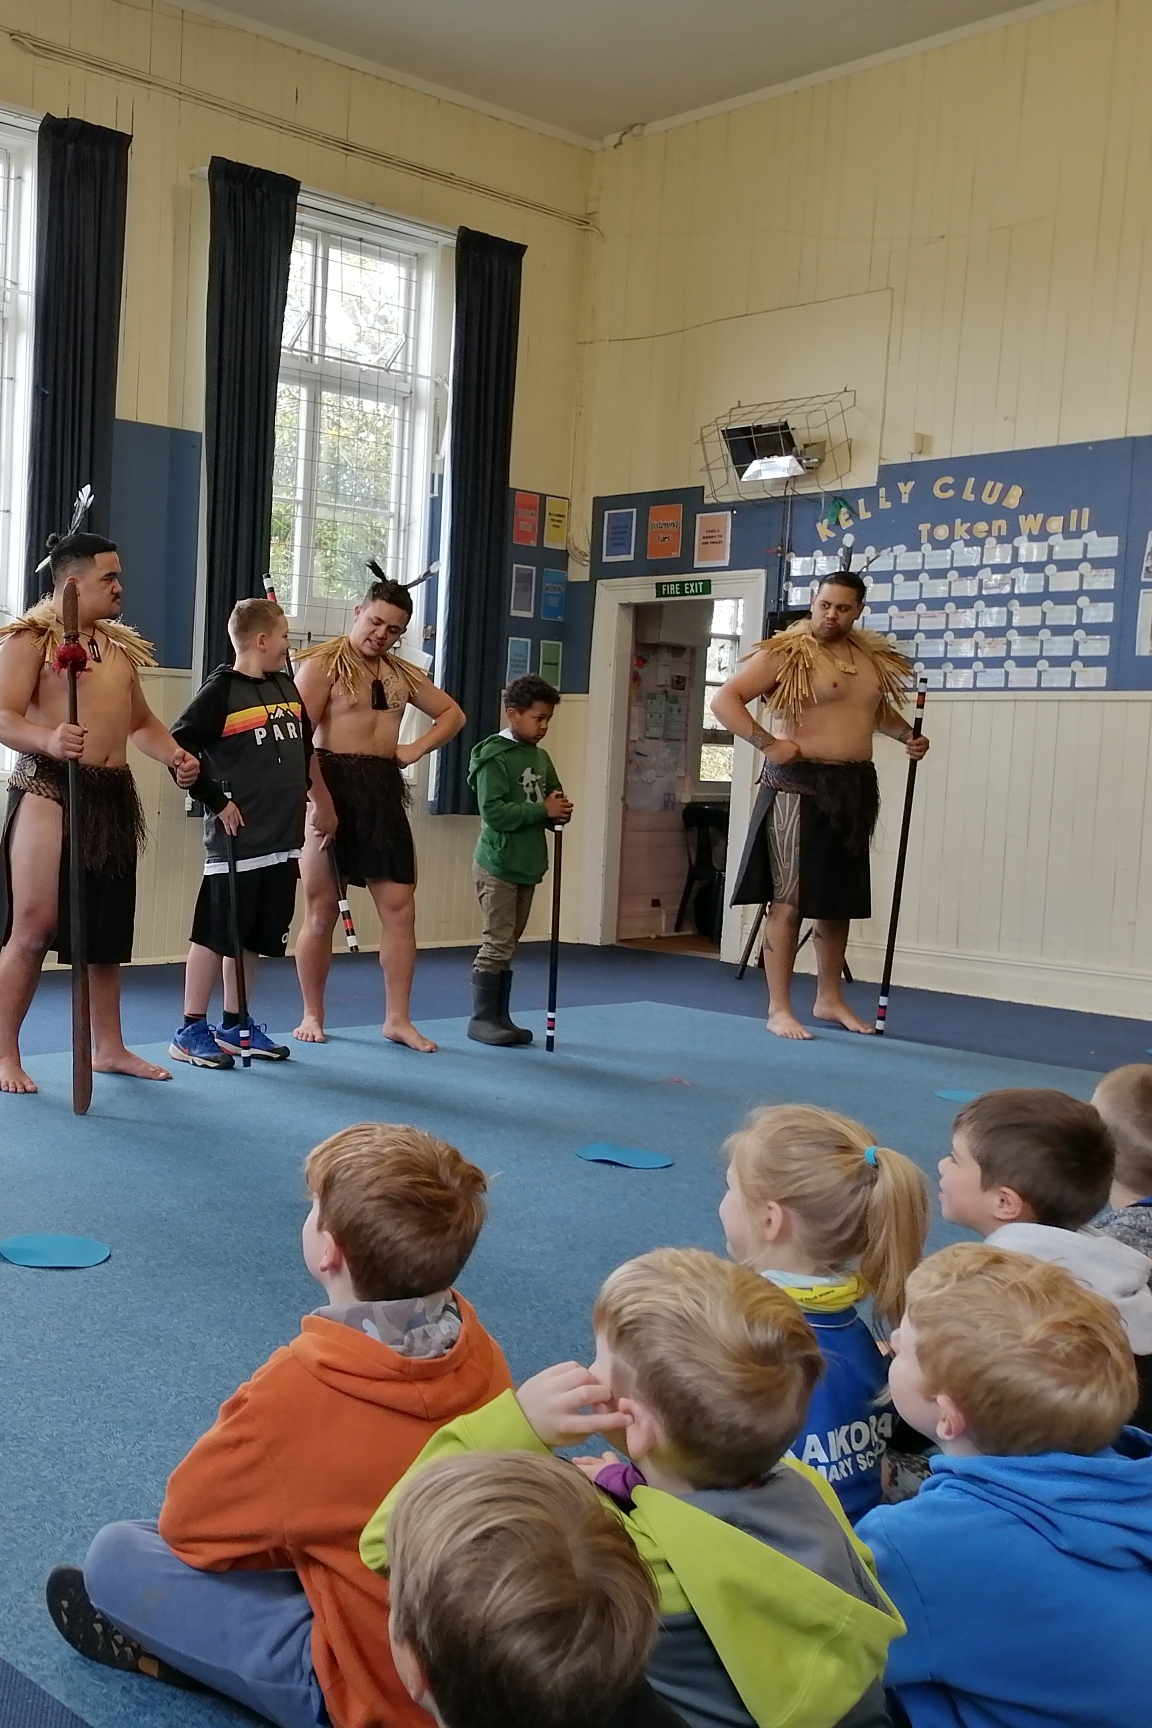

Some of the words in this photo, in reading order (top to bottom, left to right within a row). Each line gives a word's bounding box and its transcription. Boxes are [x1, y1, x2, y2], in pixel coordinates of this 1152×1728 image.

[816, 480, 915, 542] KELLY
[933, 476, 1024, 509] CLUB
[918, 518, 1007, 544] Token
[1019, 507, 1090, 536] Wall
[661, 583, 681, 595] FIRE
[684, 581, 704, 594] EXIT
